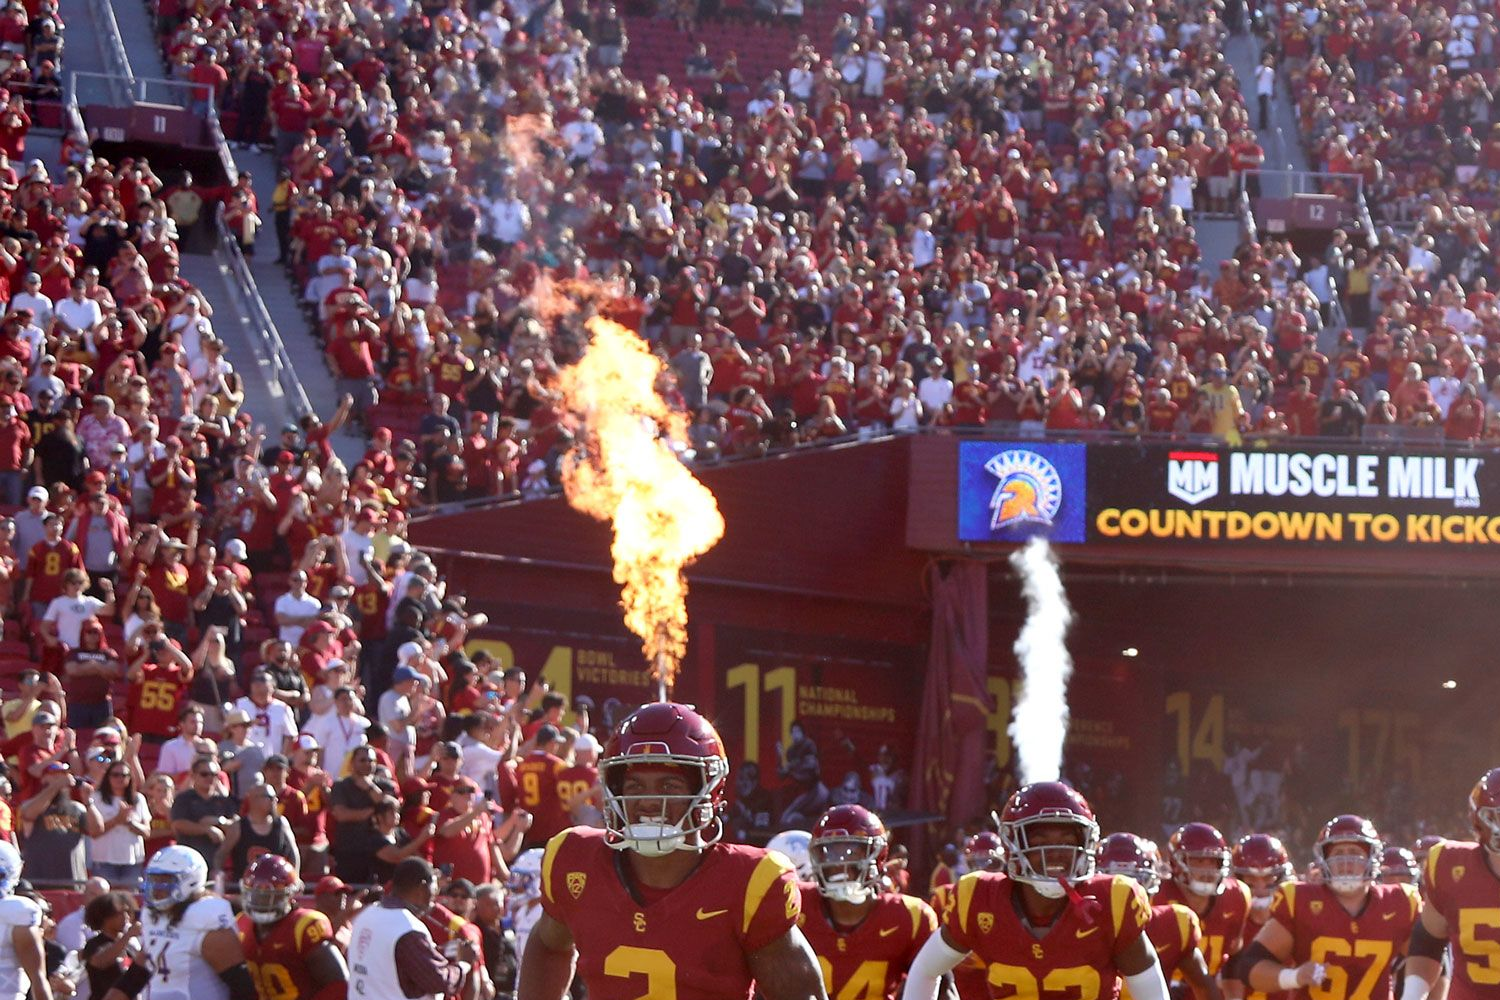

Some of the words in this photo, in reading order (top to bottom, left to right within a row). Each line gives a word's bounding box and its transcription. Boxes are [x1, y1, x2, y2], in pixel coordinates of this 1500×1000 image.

[1229, 452, 1380, 498] MUSCLE
[1387, 456, 1481, 499] MILK
[1096, 508, 1343, 541] COUNTDOWN
[1347, 512, 1400, 542] TO
[576, 649, 615, 666] BOWL
[576, 666, 651, 687] VICTORIES
[799, 685, 857, 703] NATIONAL
[726, 663, 797, 769] 11
[799, 700, 896, 723] CHAMPIONSHIPS
[1165, 690, 1226, 778] 14
[523, 771, 540, 806] 9
